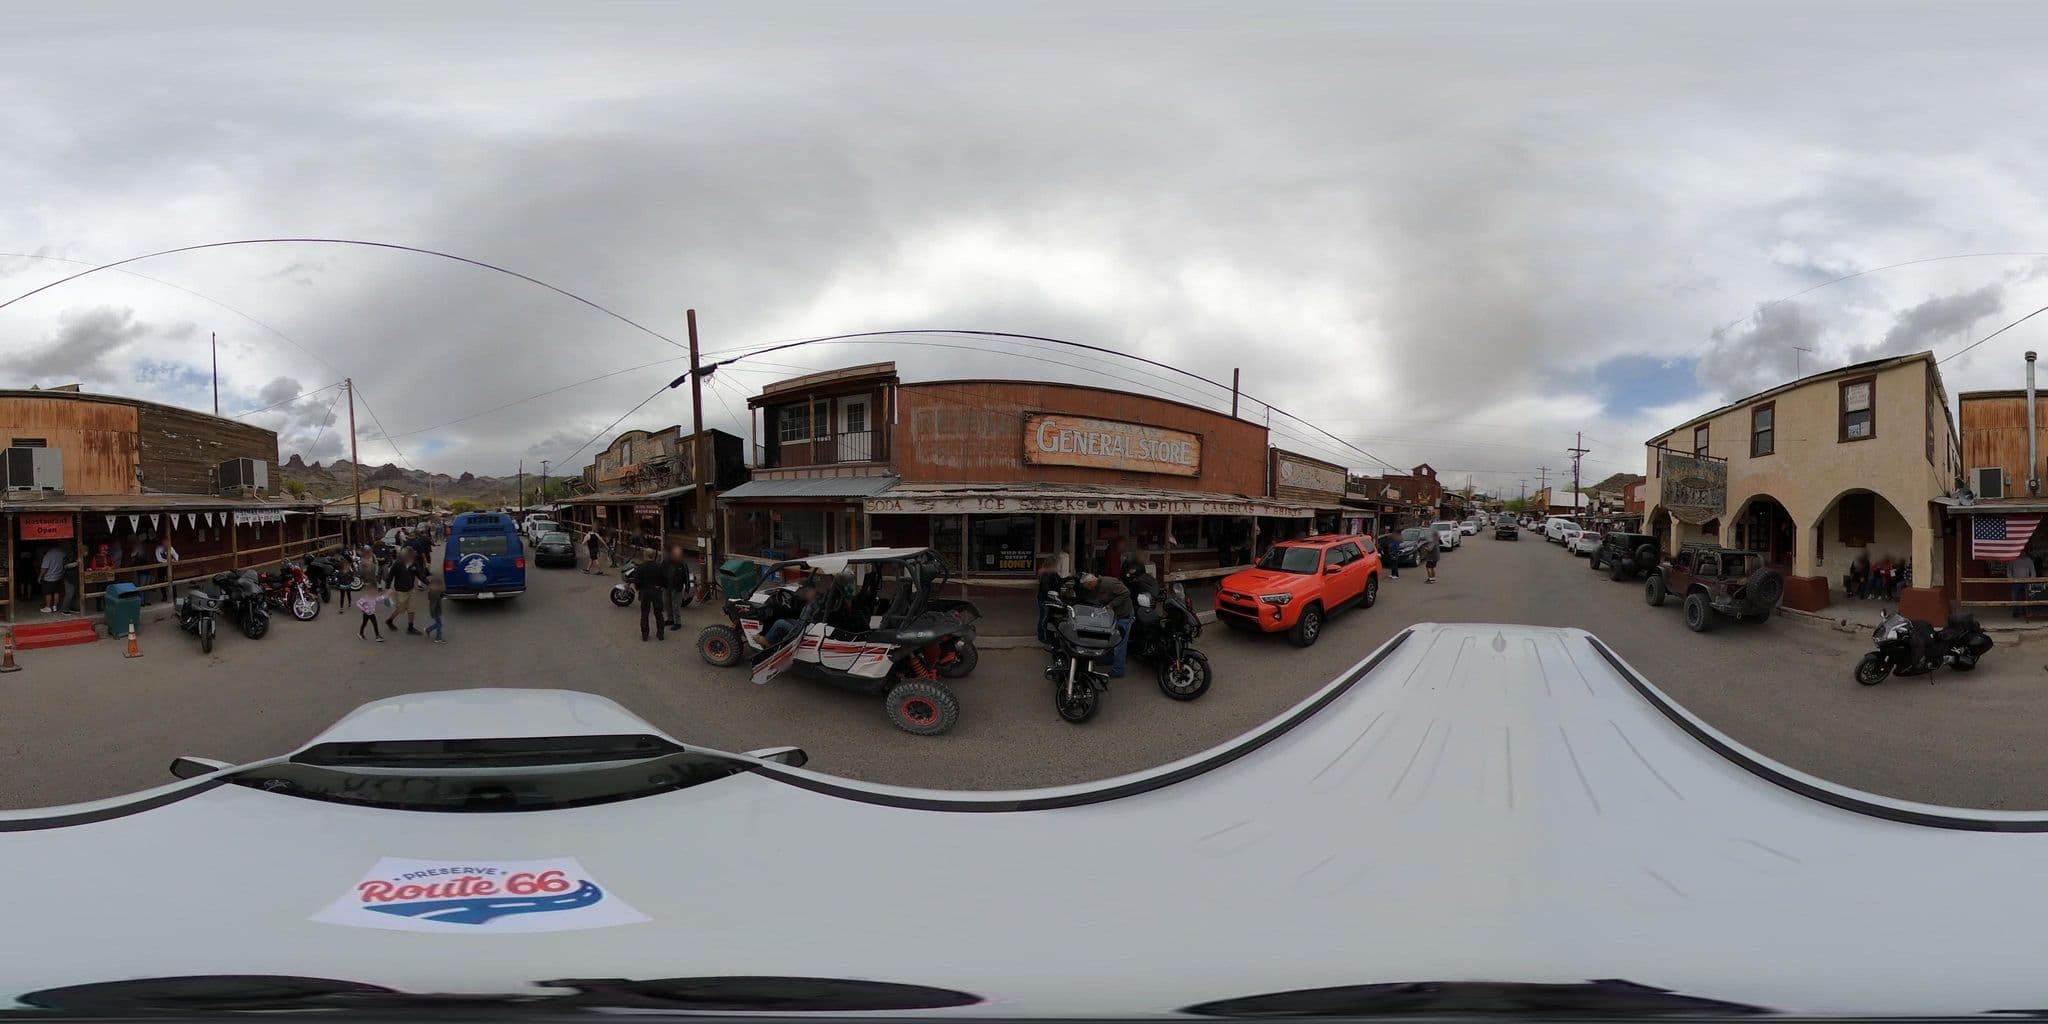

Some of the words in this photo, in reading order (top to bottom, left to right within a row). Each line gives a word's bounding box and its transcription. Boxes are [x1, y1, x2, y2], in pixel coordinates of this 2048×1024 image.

[1036, 420, 1136, 458] GENERAL
[1138, 438, 1193, 465] STORE
[867, 499, 903, 512] SODA
[977, 498, 1006, 511] ICE
[1159, 501, 1191, 513] FILM
[1203, 502, 1256, 514] CAMERAS
[1000, 560, 1032, 568] HONEY
[401, 867, 498, 882] PRESERVE
[358, 874, 501, 903] Route
[505, 870, 571, 896] 66
